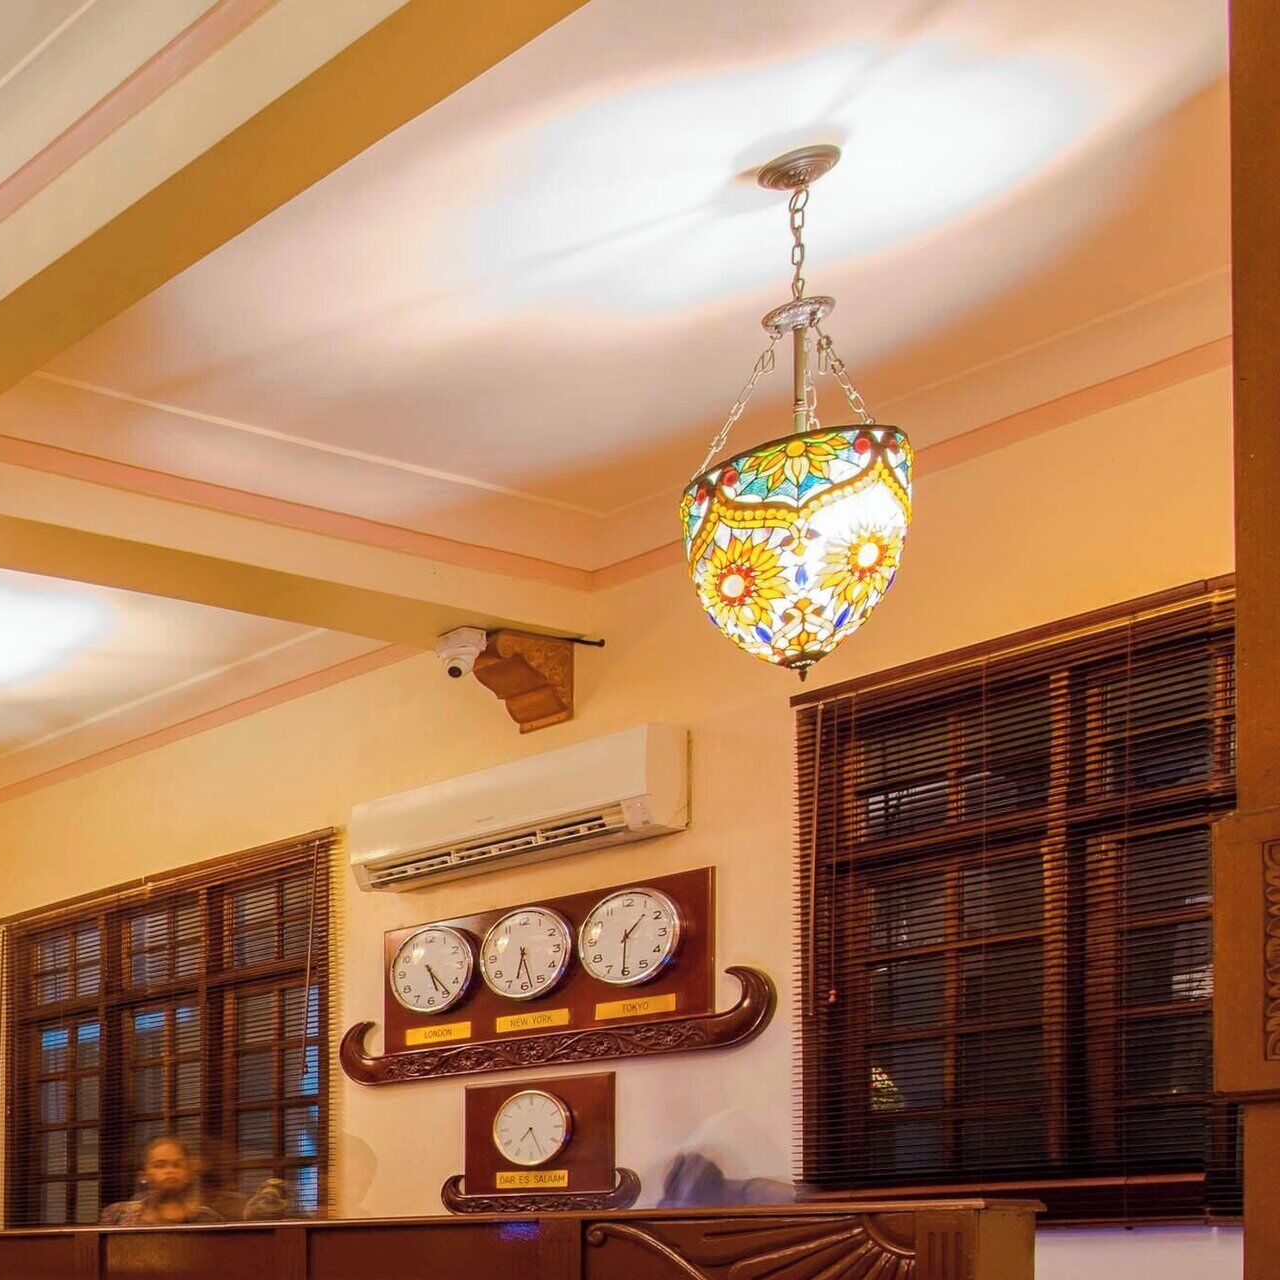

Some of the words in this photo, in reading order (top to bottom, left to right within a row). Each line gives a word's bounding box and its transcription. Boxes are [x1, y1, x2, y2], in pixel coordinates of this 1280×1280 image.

[622, 898, 634, 907] 12
[606, 908, 613, 916] 11
[653, 911, 662, 920] 2
[519, 918, 530, 926] 12
[505, 925, 512, 935] 11
[547, 928, 556, 937] 2
[658, 928, 667, 936] 3
[425, 936, 435, 944] 12
[451, 946, 459, 955] 2
[552, 944, 561, 953] 3
[653, 945, 661, 953] 4
[402, 955, 411, 964] 10
[488, 955, 497, 964] 9
[592, 954, 603, 963] 8
[457, 961, 464, 970] 3
[548, 960, 557, 969] 4
[639, 960, 648, 968] 5
[494, 970, 503, 978] 8
[605, 965, 613, 974] 7
[621, 967, 630, 976] 6
[398, 970, 406, 979] 9
[536, 975, 545, 983] 5
[452, 976, 459, 984] 4
[506, 980, 513, 989] 7
[403, 985, 412, 994] 8
[520, 982, 529, 990] 6
[414, 994, 420, 1003] 7
[427, 996, 435, 1005] 6
[622, 1001, 649, 1013] TOKYO
[510, 1017, 528, 1029] NEW
[532, 1013, 553, 1025] YORK
[424, 1028, 452, 1039] LONDON
[500, 1176, 515, 1185] DAR
[518, 1175, 530, 1184] ES
[533, 1174, 565, 1184] SALAAM
